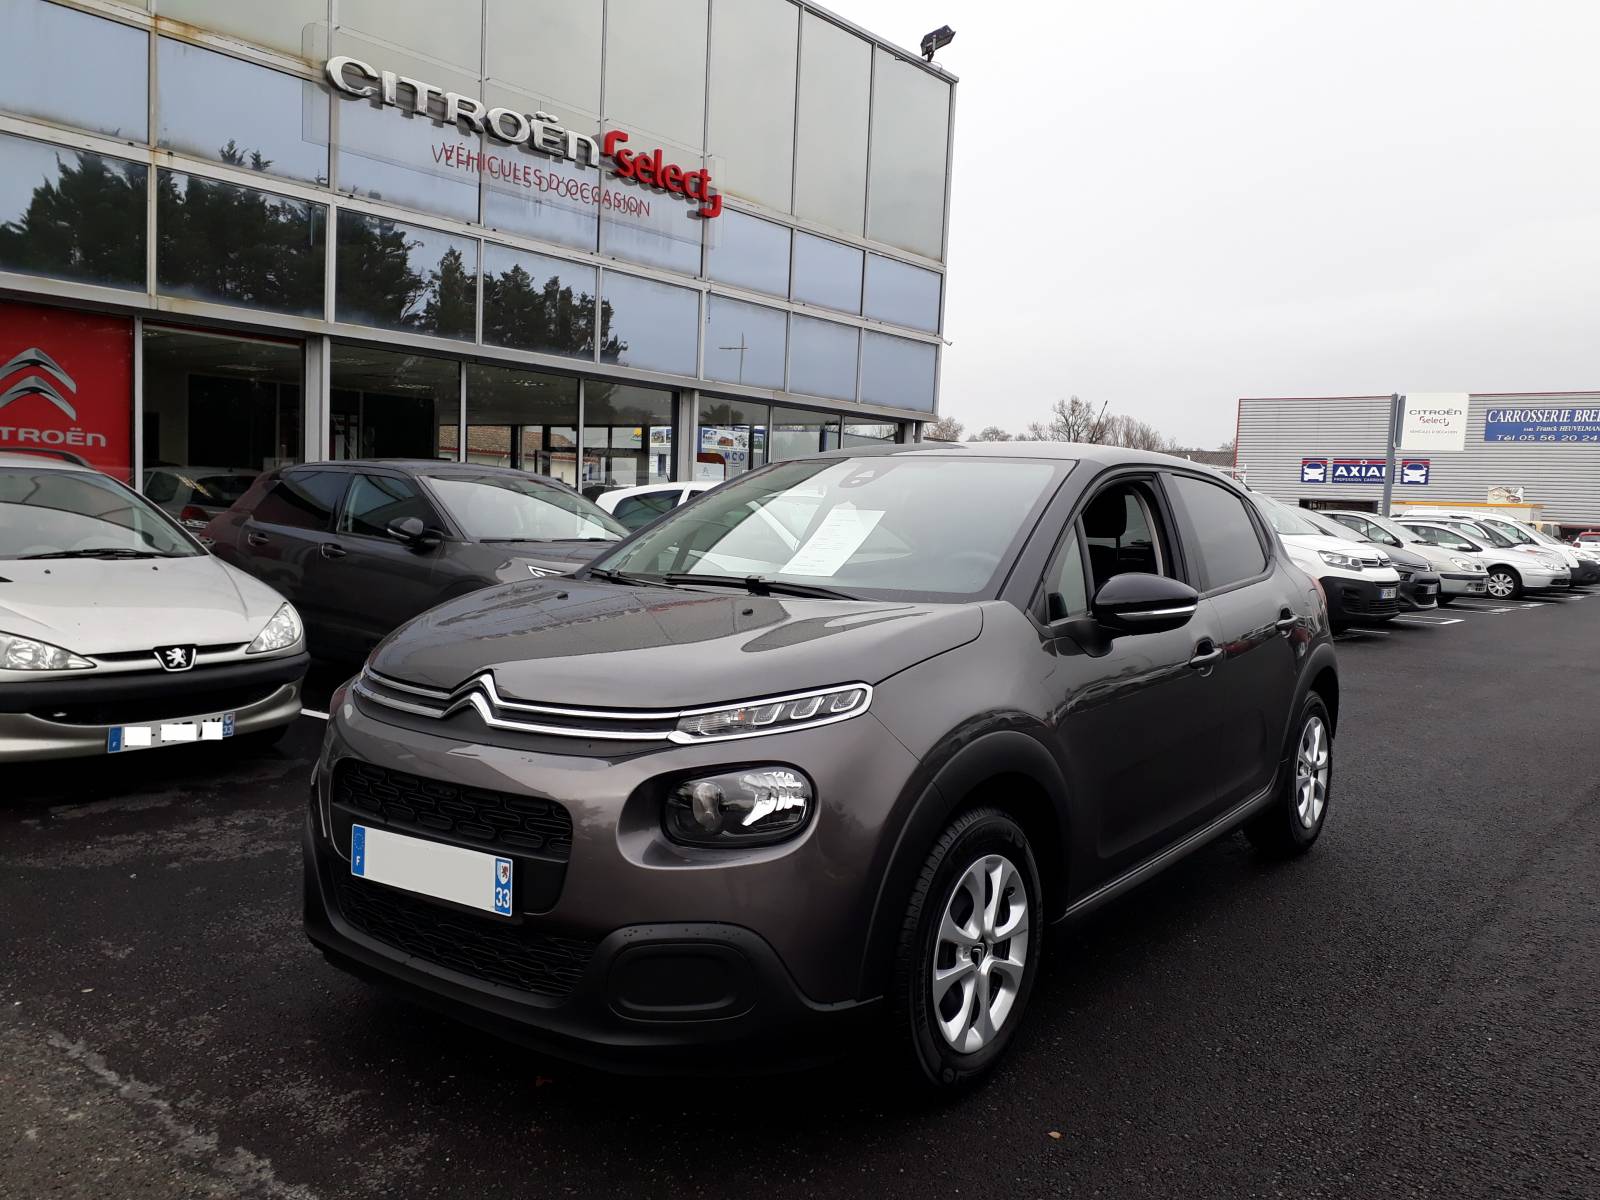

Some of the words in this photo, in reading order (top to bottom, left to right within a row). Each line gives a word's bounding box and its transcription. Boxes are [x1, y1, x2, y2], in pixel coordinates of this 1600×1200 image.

[440, 142, 543, 187] VÉHICULES
[549, 172, 650, 217] D'OCCASION
[612, 145, 715, 203] select
[1488, 409, 1572, 423] CARROSSERIE
[223, 725, 233, 734] 33
[355, 856, 361, 867] F
[495, 887, 510, 908] 33
